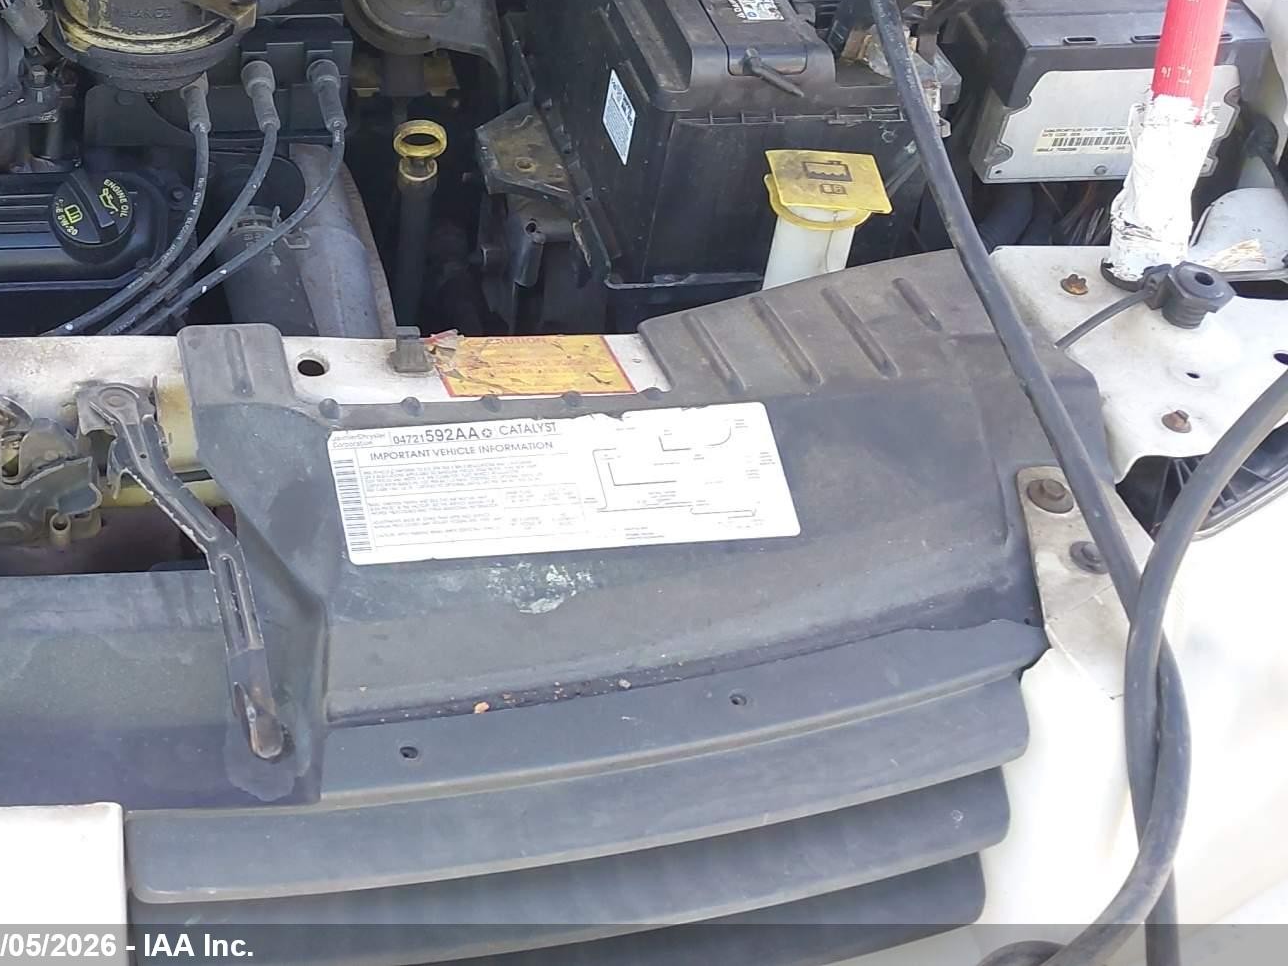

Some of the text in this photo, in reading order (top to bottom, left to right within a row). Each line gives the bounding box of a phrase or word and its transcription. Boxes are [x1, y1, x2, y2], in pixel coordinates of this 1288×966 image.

[103, 179, 129, 218] ENGINE OIL
[498, 422, 558, 436] CATALYST
[370, 441, 554, 462] IMPORTANT VEHICLE INFORMATION
